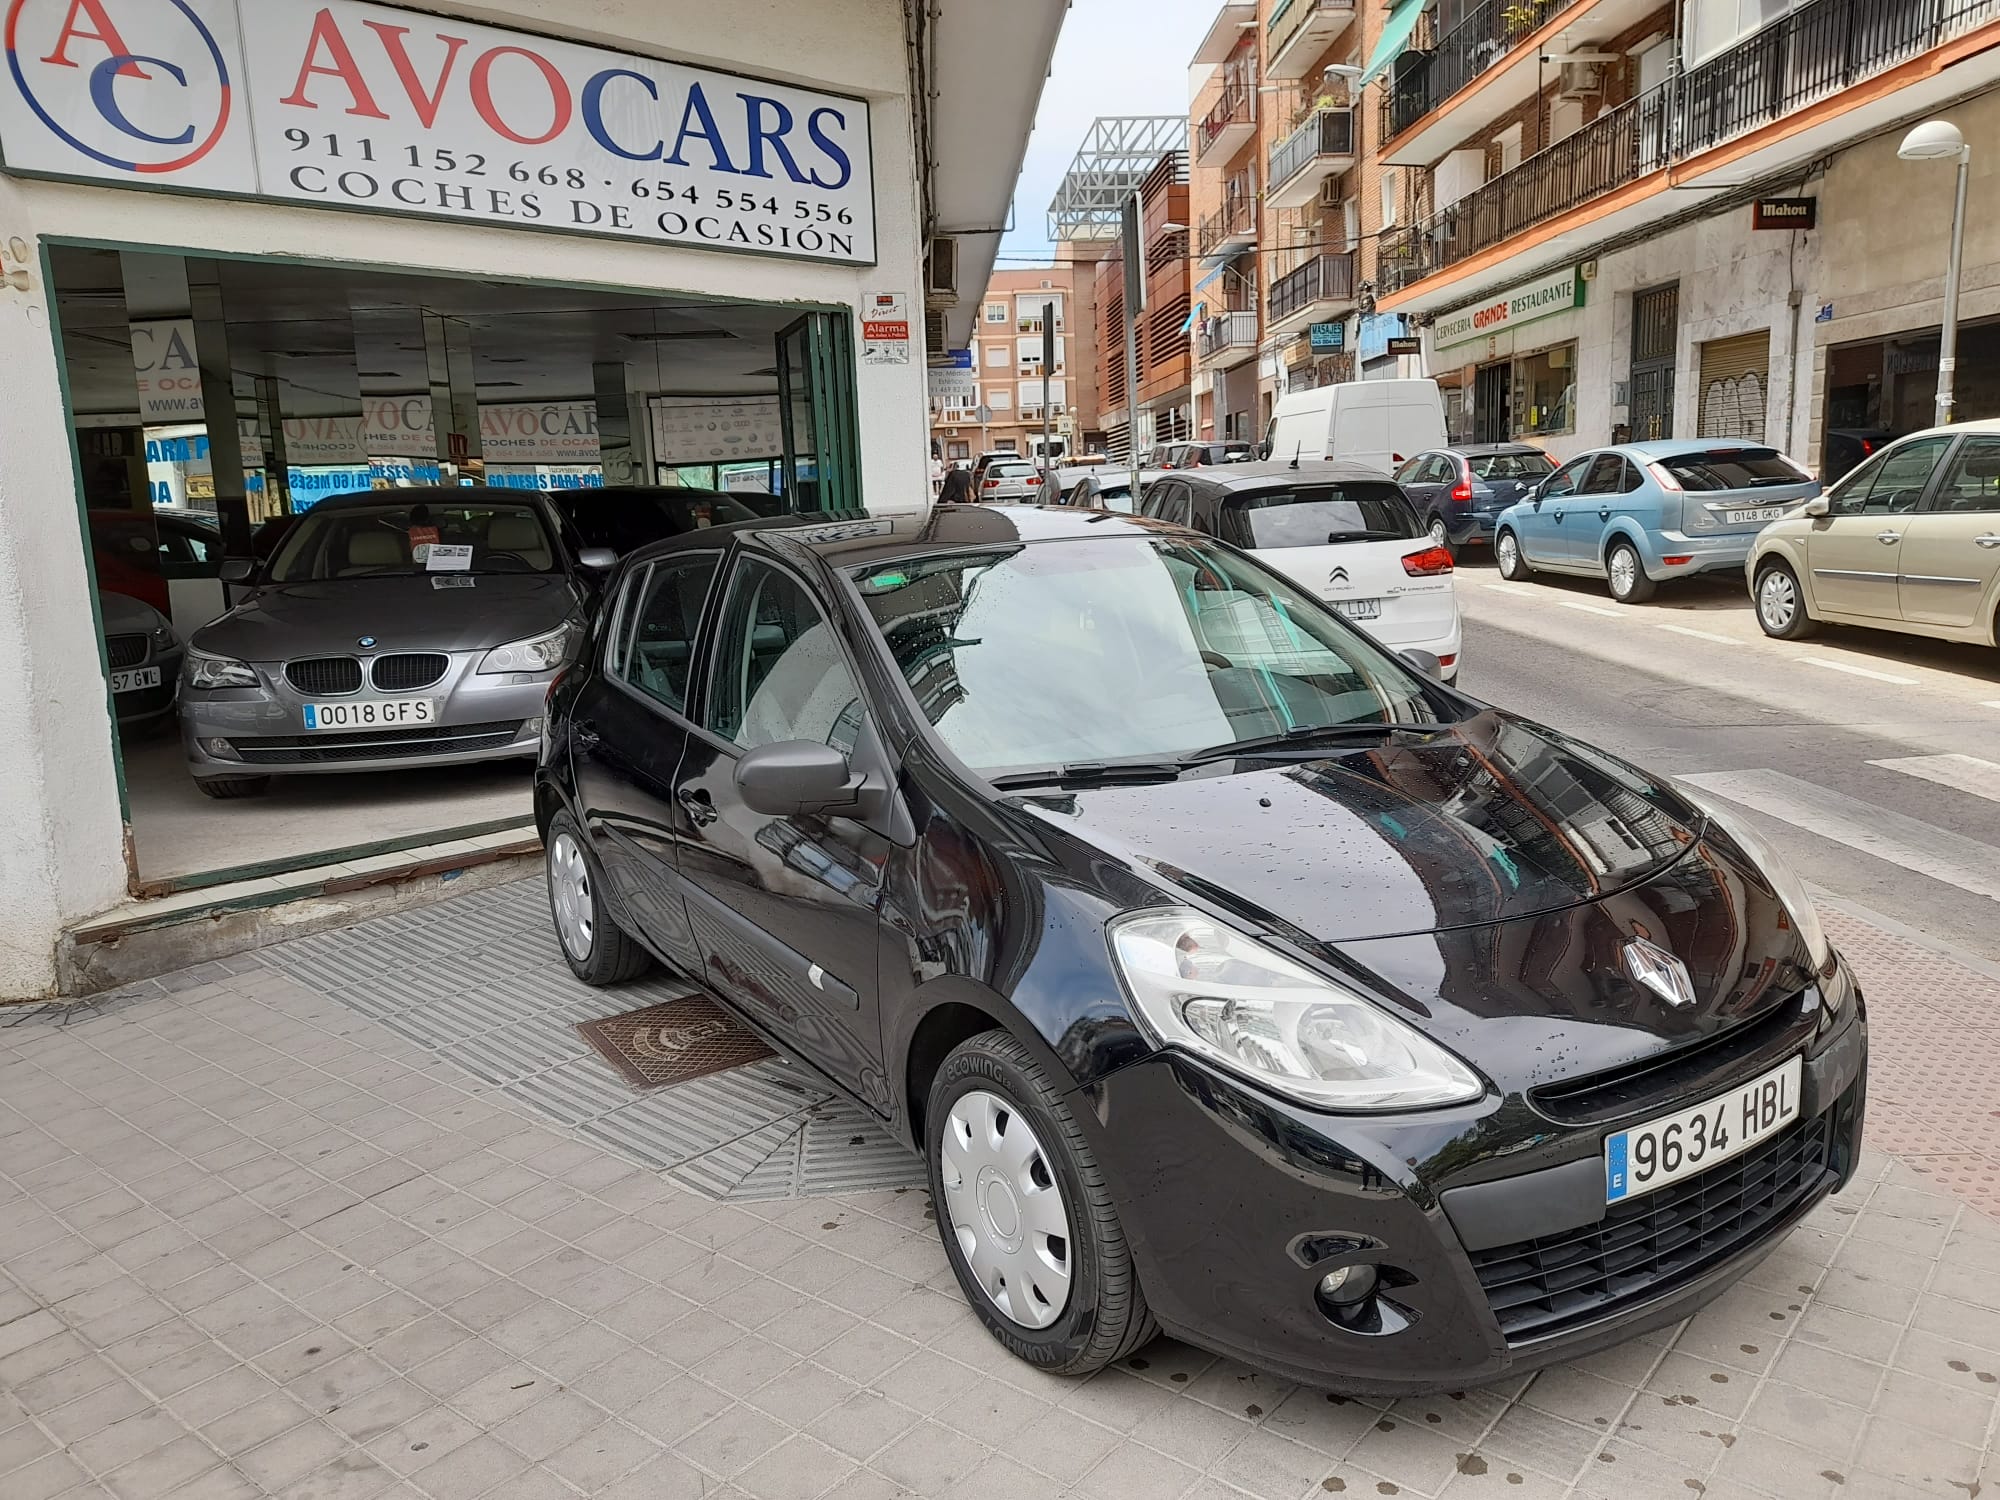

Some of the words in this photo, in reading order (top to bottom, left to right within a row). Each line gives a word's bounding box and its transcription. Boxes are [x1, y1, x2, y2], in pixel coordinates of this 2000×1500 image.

[280, 7, 852, 190] AVOCARS
[283, 126, 380, 162] 911
[409, 144, 487, 176] 152
[508, 160, 586, 190] 668
[631, 177, 699, 202] 654
[715, 188, 781, 217] 554
[794, 200, 854, 225] 556
[290, 164, 544, 219] COCHES
[571, 199, 632, 230] DE
[658, 211, 854, 255] OCASIÓN
[1763, 203, 1807, 217] Mahou
[1436, 317, 1471, 341] CERVECERIA
[1473, 301, 1508, 329] GRANDE
[1511, 280, 1572, 314] RESTAURANTE
[867, 324, 906, 332] Alarma
[1312, 324, 1341, 334] MASAJES
[146, 438, 191, 462] ARA
[1734, 511, 1757, 521] 0148
[1349, 599, 1376, 615] LDX
[134, 670, 158, 687] GWL
[320, 704, 375, 726] 0018
[383, 700, 428, 722] GFS
[1635, 1112, 1730, 1181] 9634
[1742, 1071, 1794, 1141] HBL
